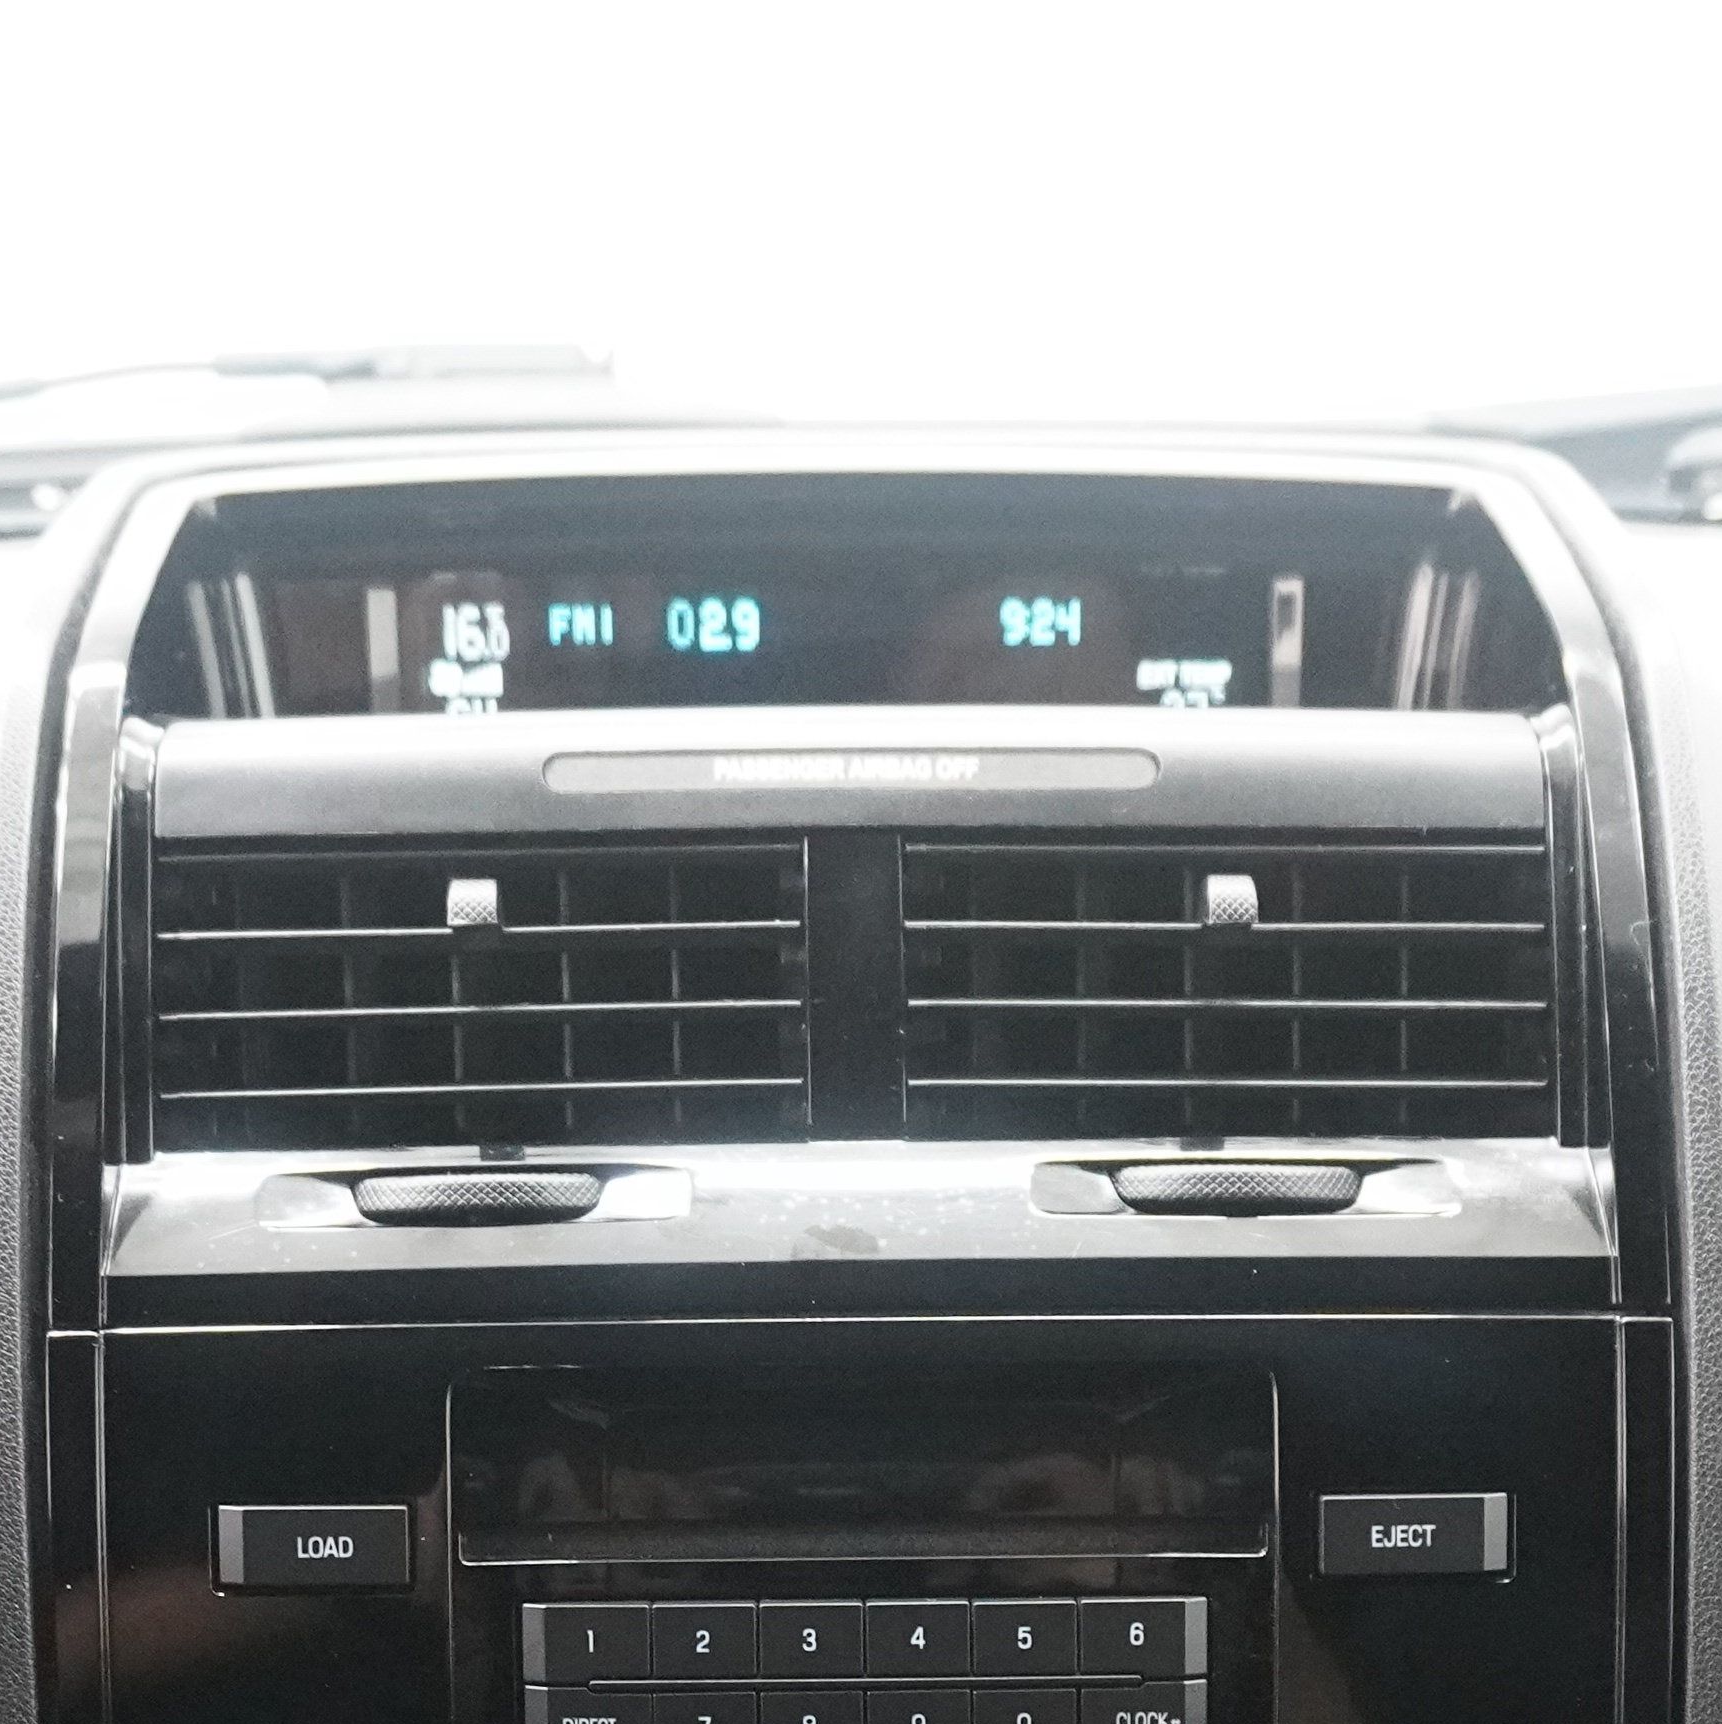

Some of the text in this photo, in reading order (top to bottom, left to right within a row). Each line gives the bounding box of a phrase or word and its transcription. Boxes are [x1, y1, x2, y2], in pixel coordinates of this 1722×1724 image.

[935, 755, 980, 781] OFF
[297, 1535, 355, 1561] LOAD
[1371, 1524, 1437, 1550] EJECT
[586, 1629, 596, 1655] 1
[695, 1629, 712, 1655] 2
[802, 1628, 819, 1654] 3
[910, 1626, 927, 1651] 4
[1017, 1626, 1034, 1652] 5
[1129, 1621, 1146, 1647] 6
